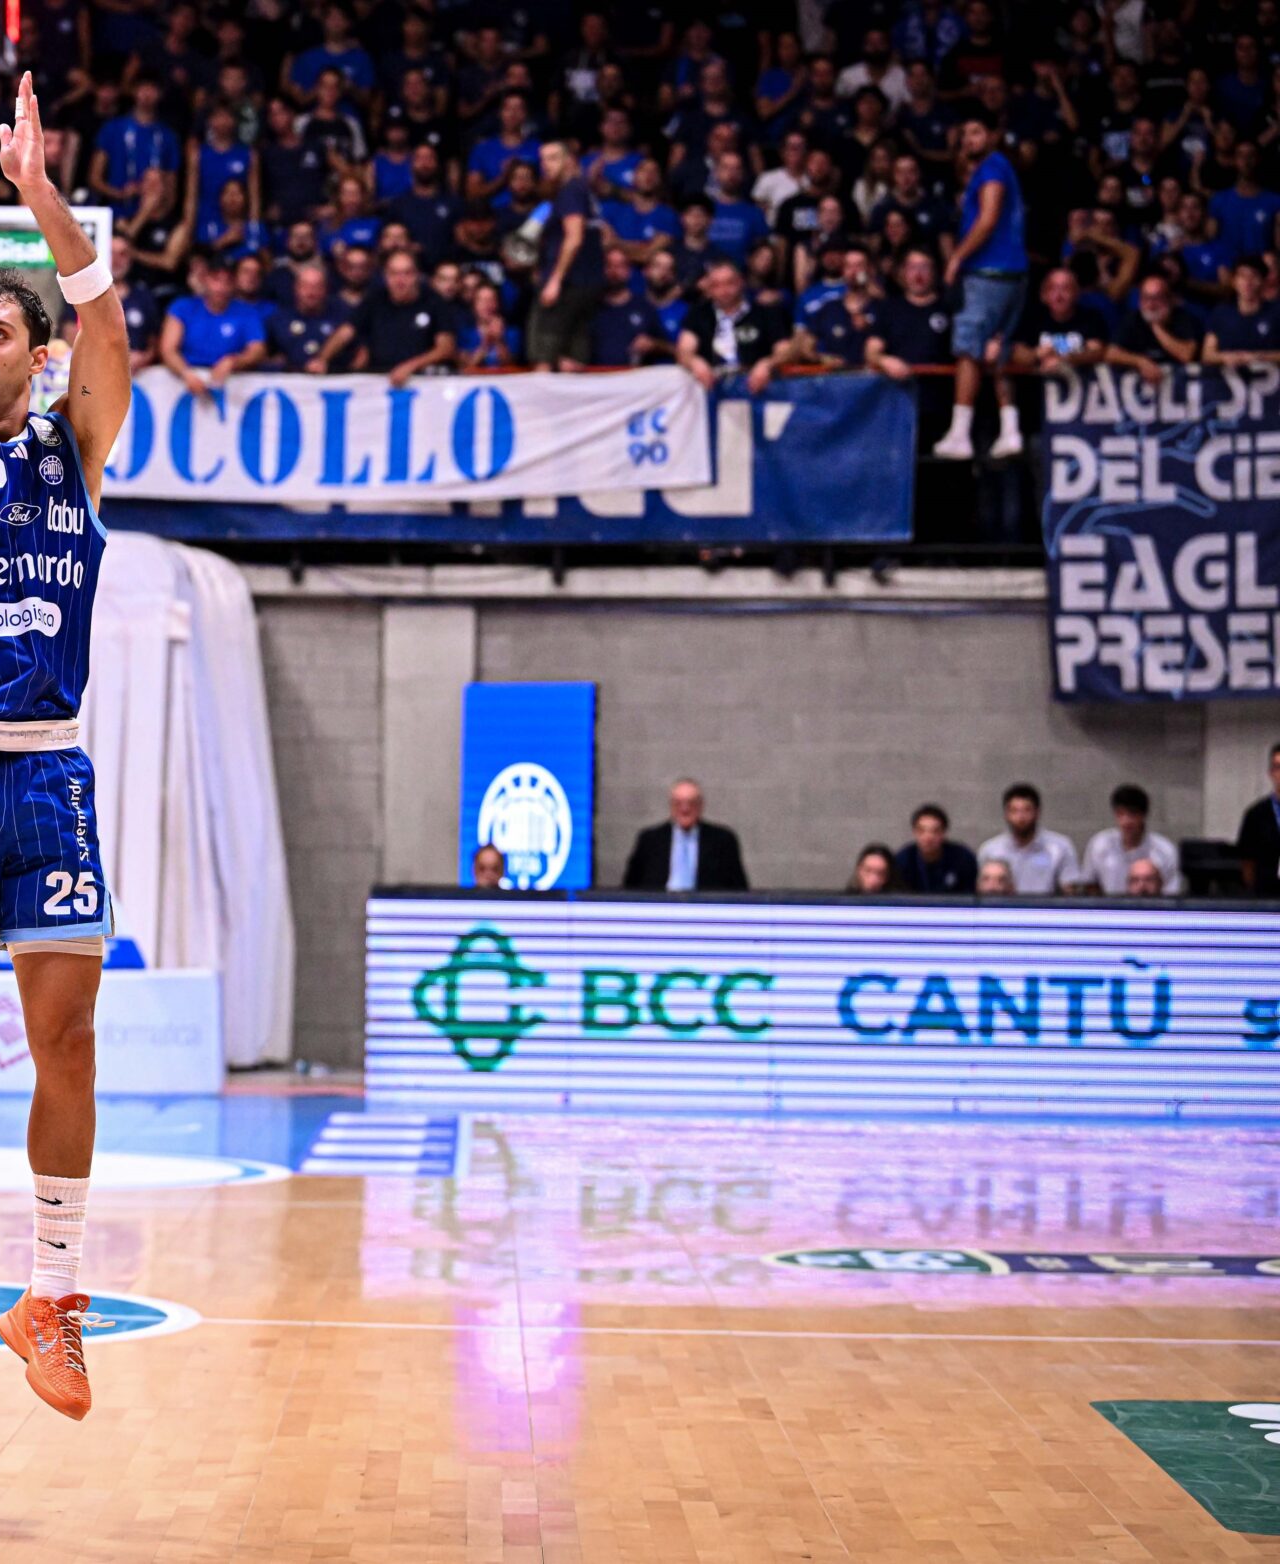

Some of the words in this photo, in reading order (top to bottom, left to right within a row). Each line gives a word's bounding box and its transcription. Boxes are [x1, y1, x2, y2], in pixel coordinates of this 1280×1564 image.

[1216, 361, 1280, 421] SP
[1050, 433, 1178, 503] DEL
[47, 496, 84, 535] tabu
[1059, 532, 1280, 612] EAGL
[1055, 612, 1280, 692] PRESE
[43, 871, 98, 917] 25
[581, 968, 775, 1037] BCC
[838, 957, 1172, 1046] CANTÙ
